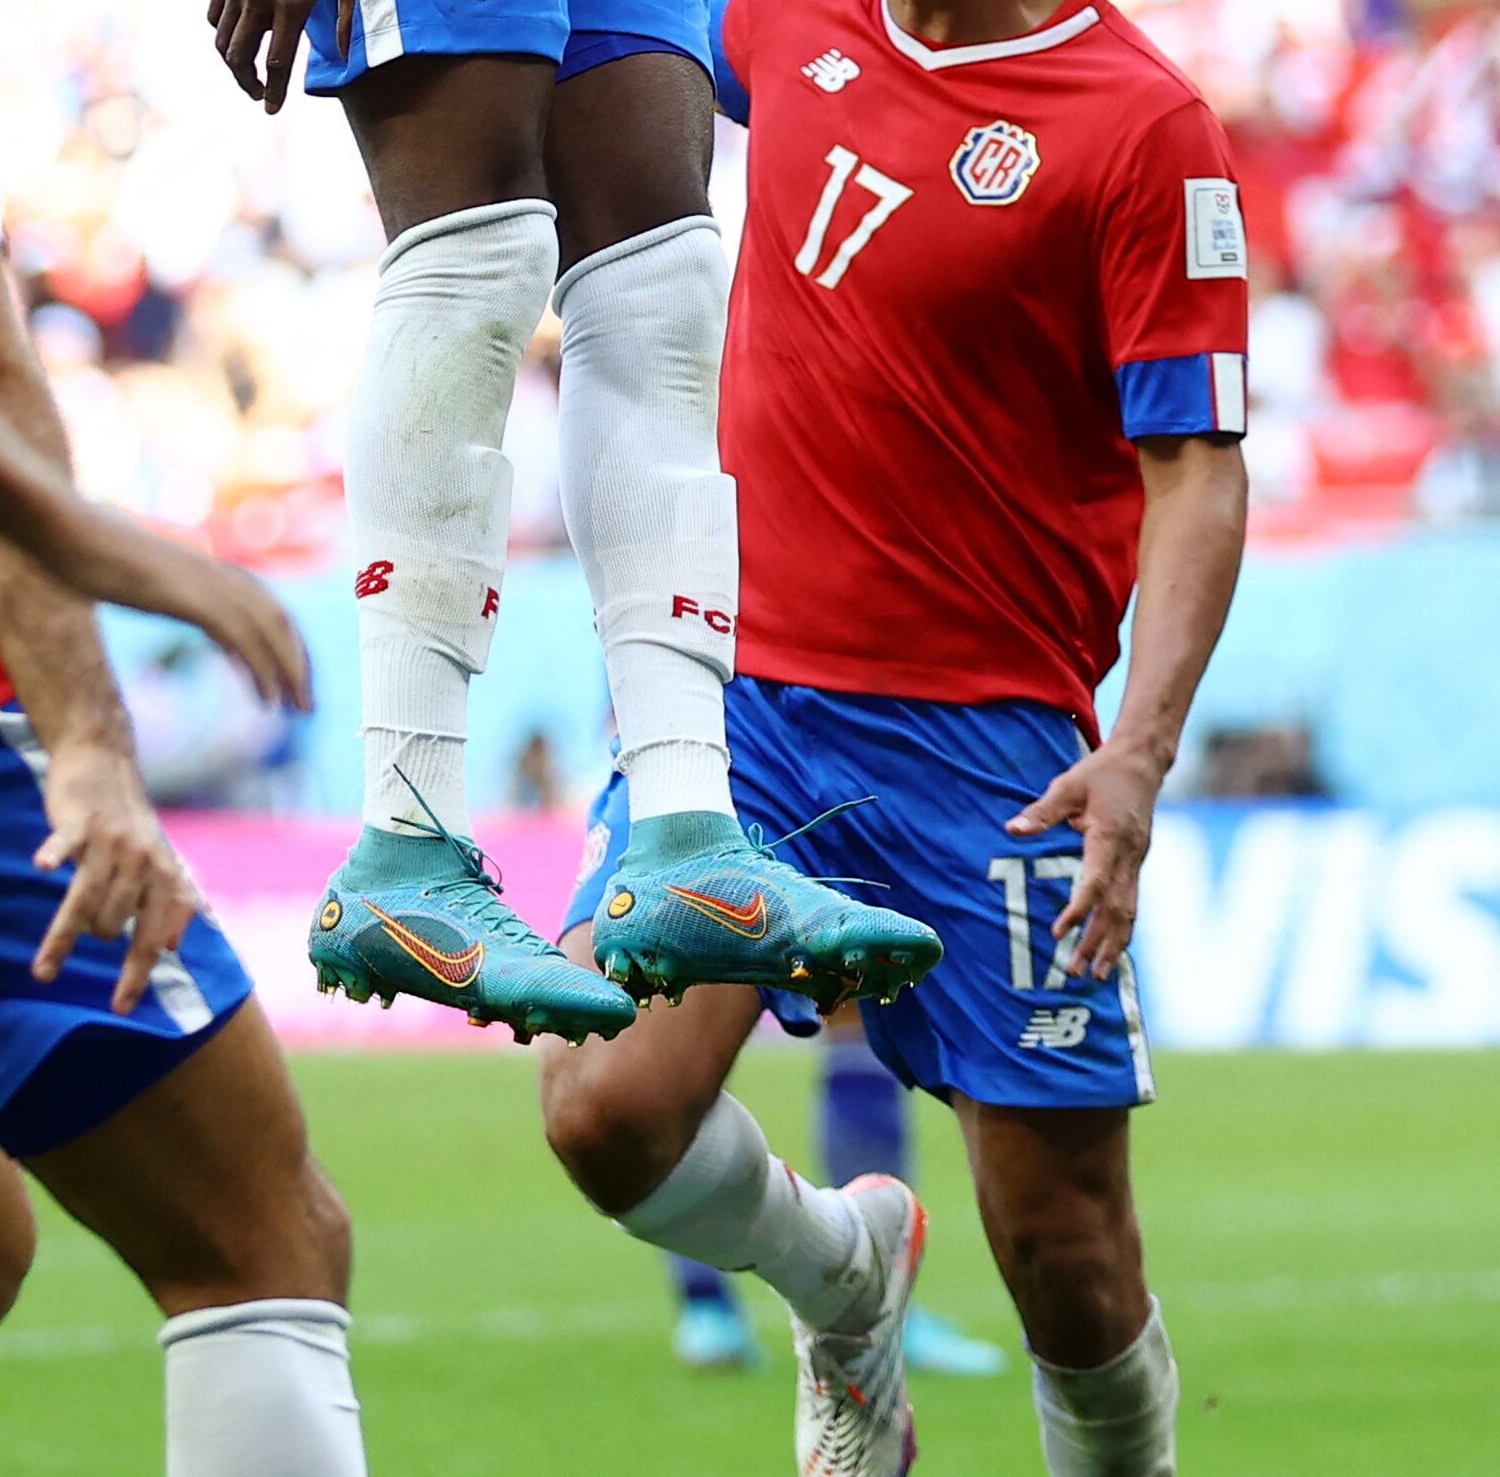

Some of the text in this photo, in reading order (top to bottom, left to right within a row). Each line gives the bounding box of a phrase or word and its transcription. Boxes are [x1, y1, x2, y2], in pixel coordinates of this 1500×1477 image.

[794, 143, 915, 291] 17
[970, 138, 1022, 190] CR
[987, 856, 1085, 990] 17
